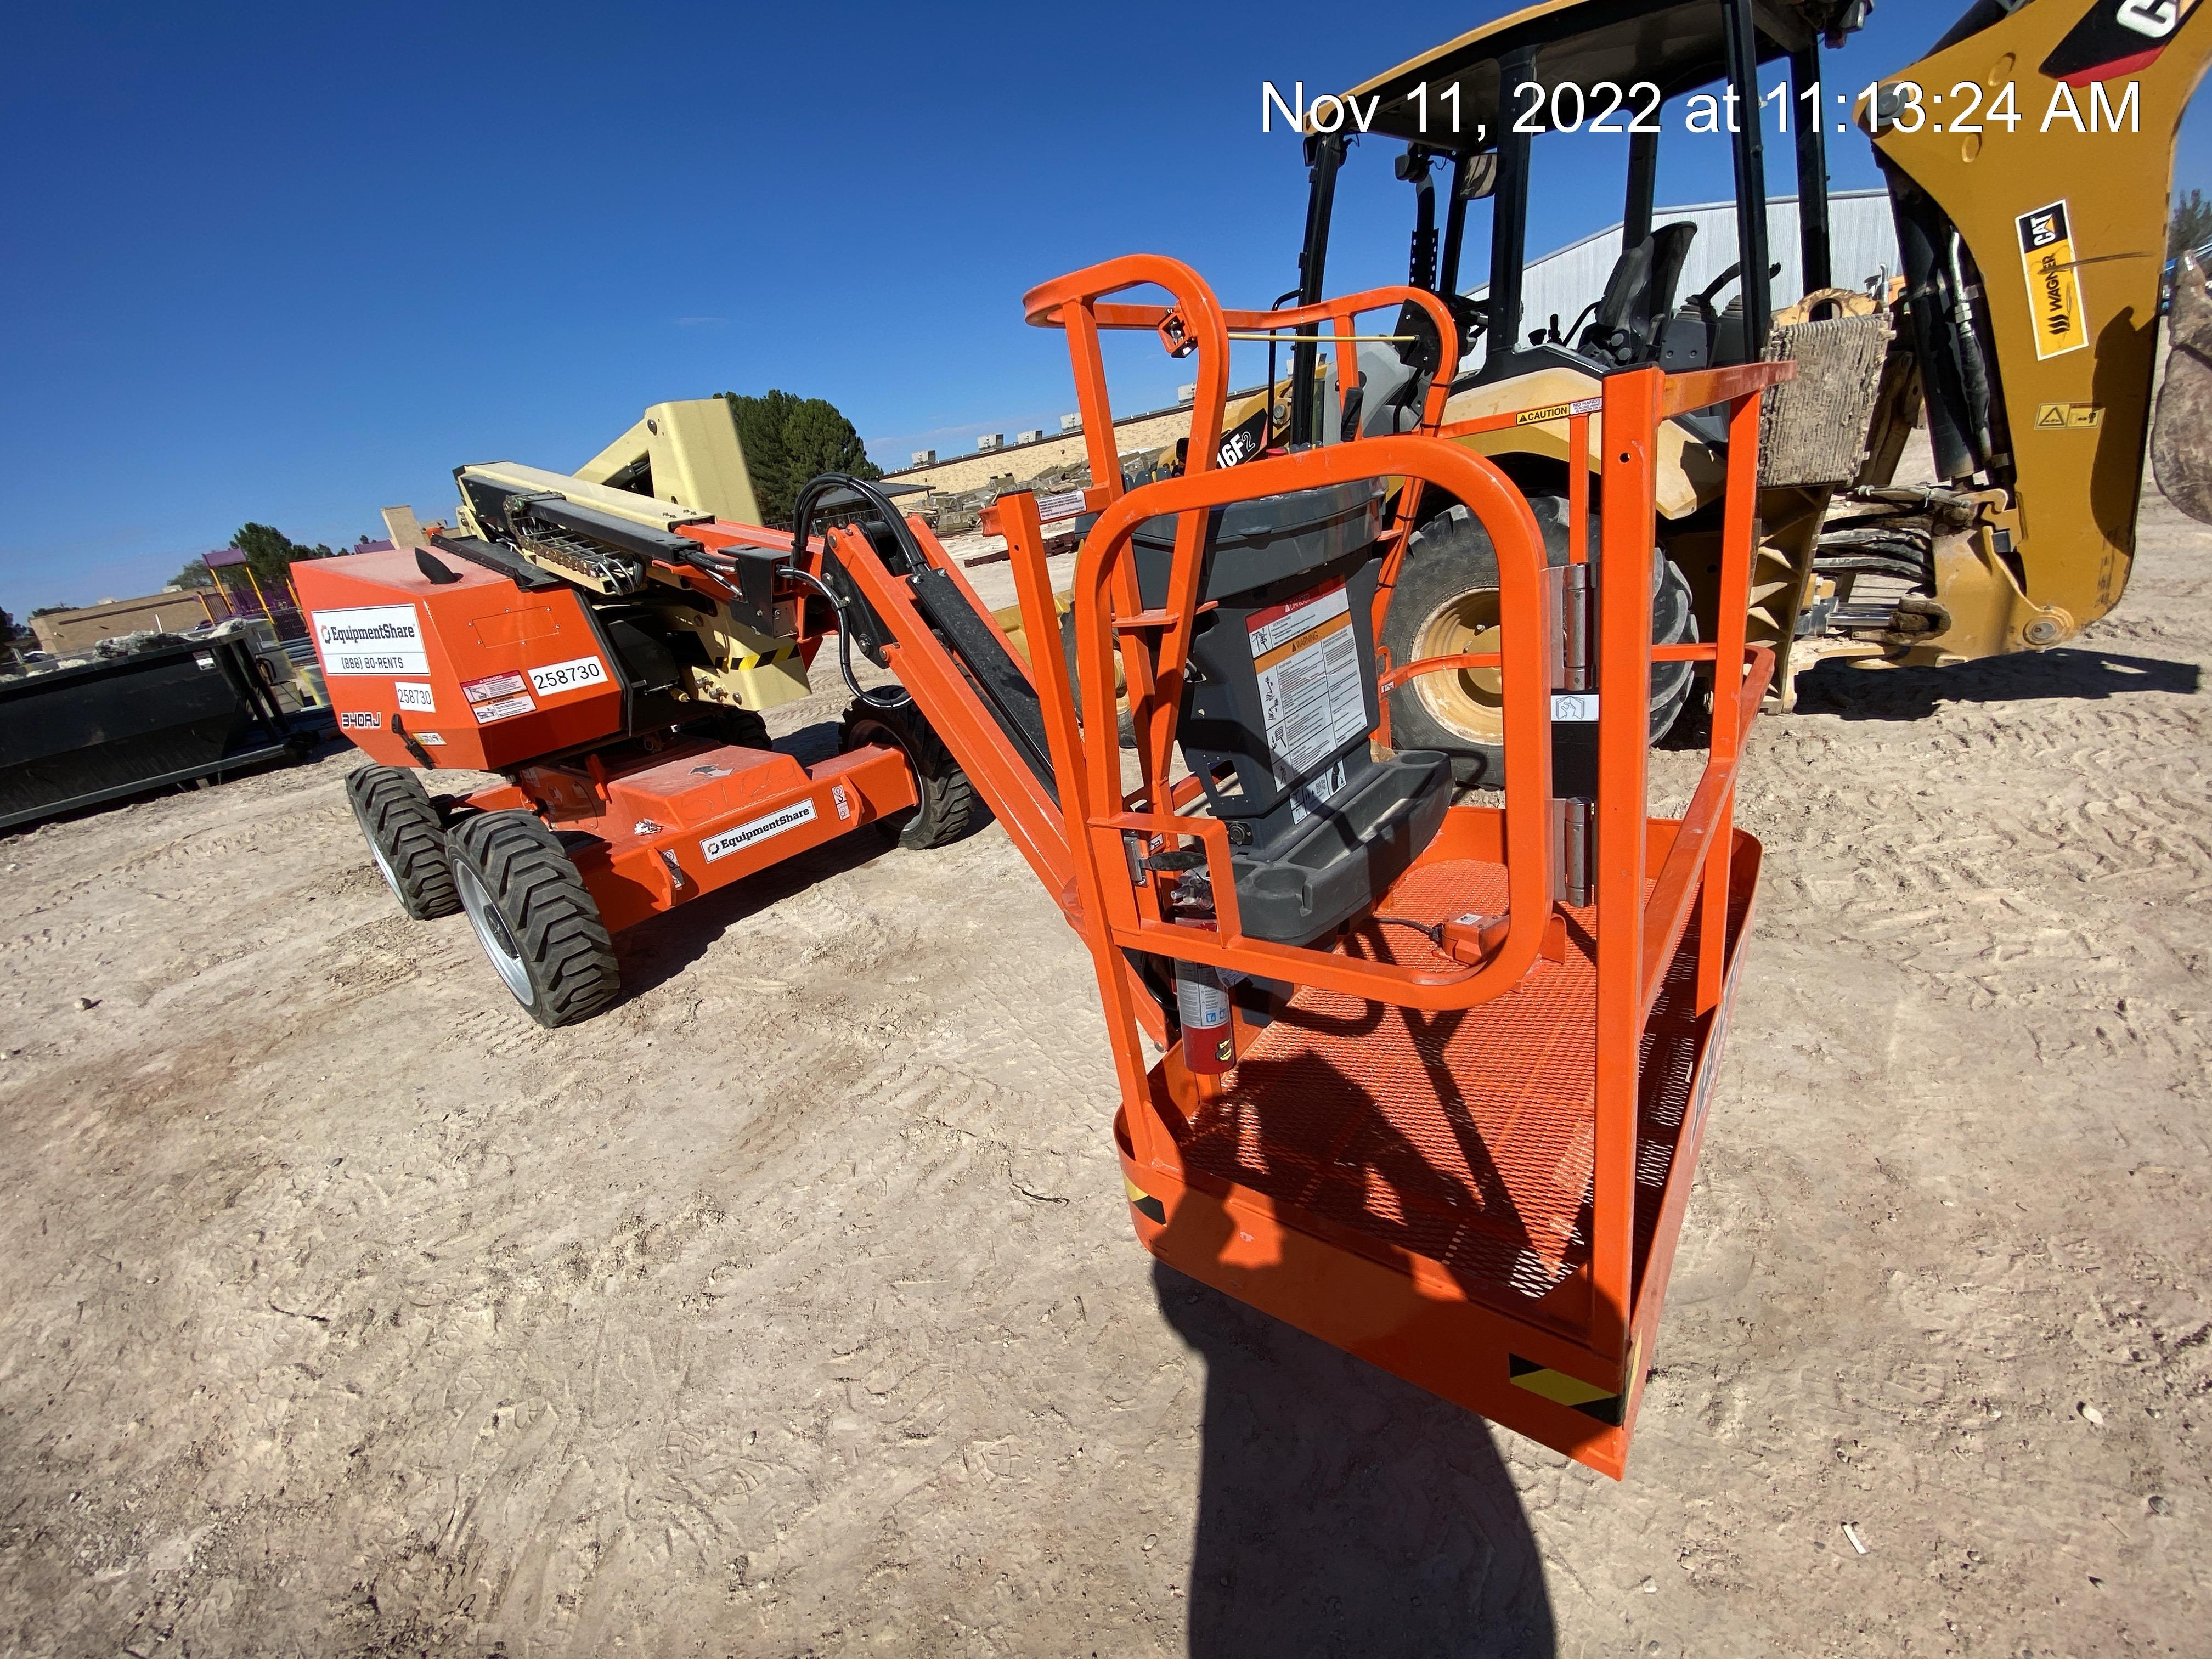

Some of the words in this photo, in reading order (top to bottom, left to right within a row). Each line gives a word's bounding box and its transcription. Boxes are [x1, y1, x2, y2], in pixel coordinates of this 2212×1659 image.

[2030, 213, 2056, 247] CAT
[1527, 406, 1567, 421] CAUTION
[330, 623, 415, 644] EquipmentShare
[1296, 631, 1319, 649] WARNING
[341, 657, 363, 670] (888)
[365, 657, 404, 669] 80-RENTS
[533, 663, 600, 690] 258730
[398, 689, 431, 705] 258730
[342, 714, 380, 727] 340AJ
[720, 808, 810, 850] EquipmentShare
